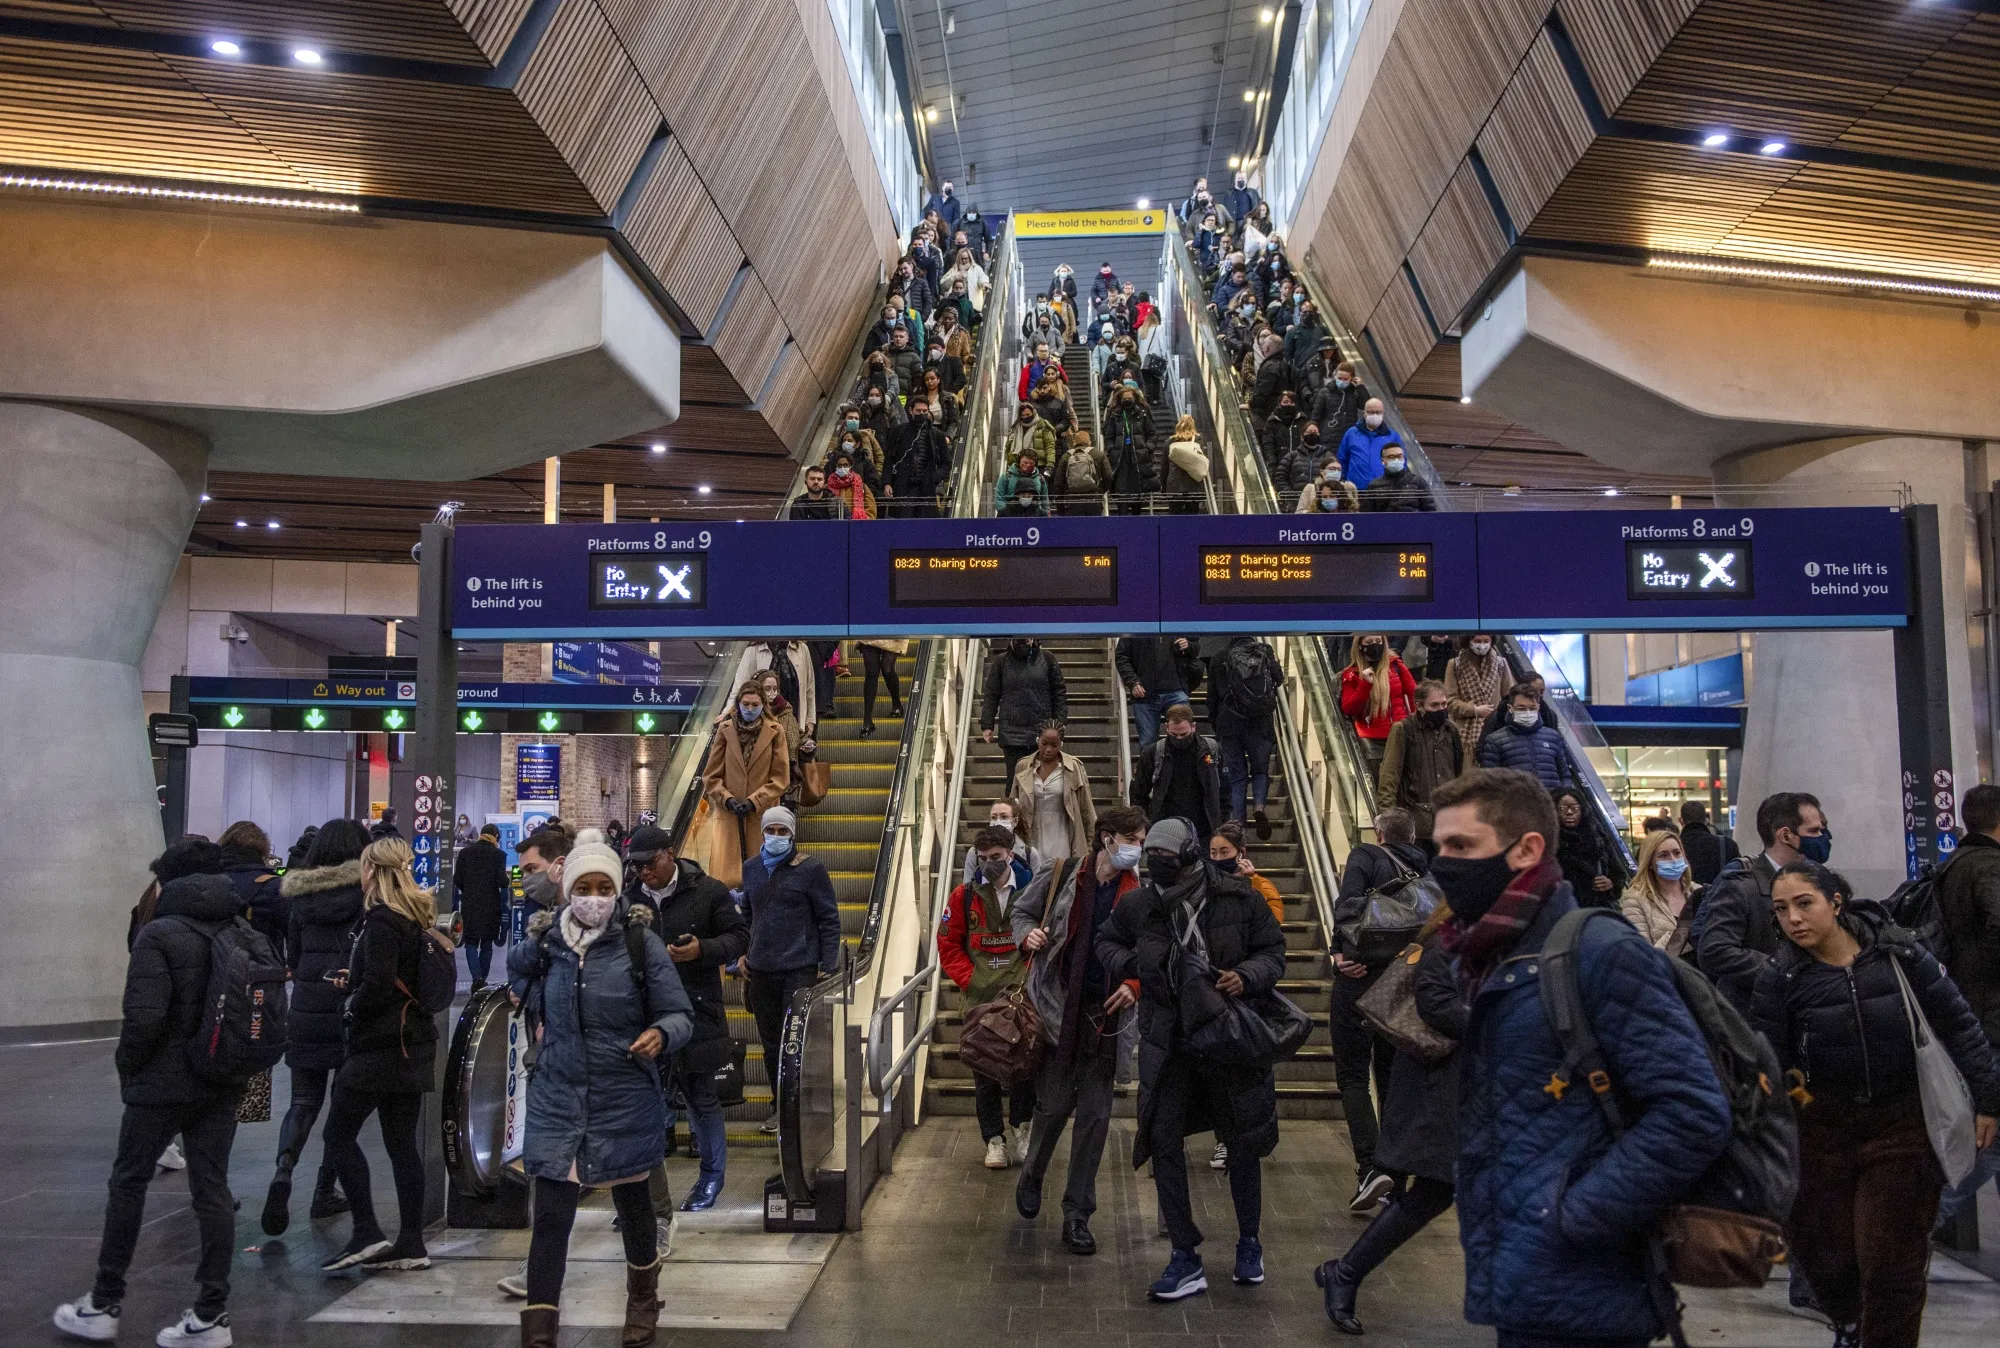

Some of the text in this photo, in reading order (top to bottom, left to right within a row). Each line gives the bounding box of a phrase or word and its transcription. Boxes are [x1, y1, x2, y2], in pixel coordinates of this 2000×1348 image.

[1026, 217, 1138, 228] Please hold the handrail
[1279, 523, 1355, 542] Platform 8
[1622, 518, 1754, 538] Platforms 8 and 9
[588, 531, 712, 550] Platforms 8 and 9
[966, 527, 1040, 546] Platform 9
[895, 558, 998, 570] 08:29 Charing Cross
[1084, 557, 1110, 566] 5 min
[1205, 554, 1311, 567] 08:27 Charing Cross
[1399, 553, 1426, 563] 3 min
[1642, 553, 1663, 568] No
[606, 566, 625, 581] No
[1205, 568, 1312, 581] 08:31 Charing Cross
[1400, 567, 1426, 578] 6 min
[1824, 563, 1888, 575] The lift is
[485, 578, 543, 590] The lift is
[1643, 570, 1690, 588] Entry
[606, 583, 649, 599] Entry
[1811, 582, 1888, 597] behind you
[471, 596, 542, 610] behind you
[336, 685, 386, 696] Way out
[457, 688, 498, 699] ground
[250, 989, 264, 1039] NIKE SB
[789, 1015, 799, 1041] HOLD ME
[446, 1134, 456, 1162] HOLD ME
